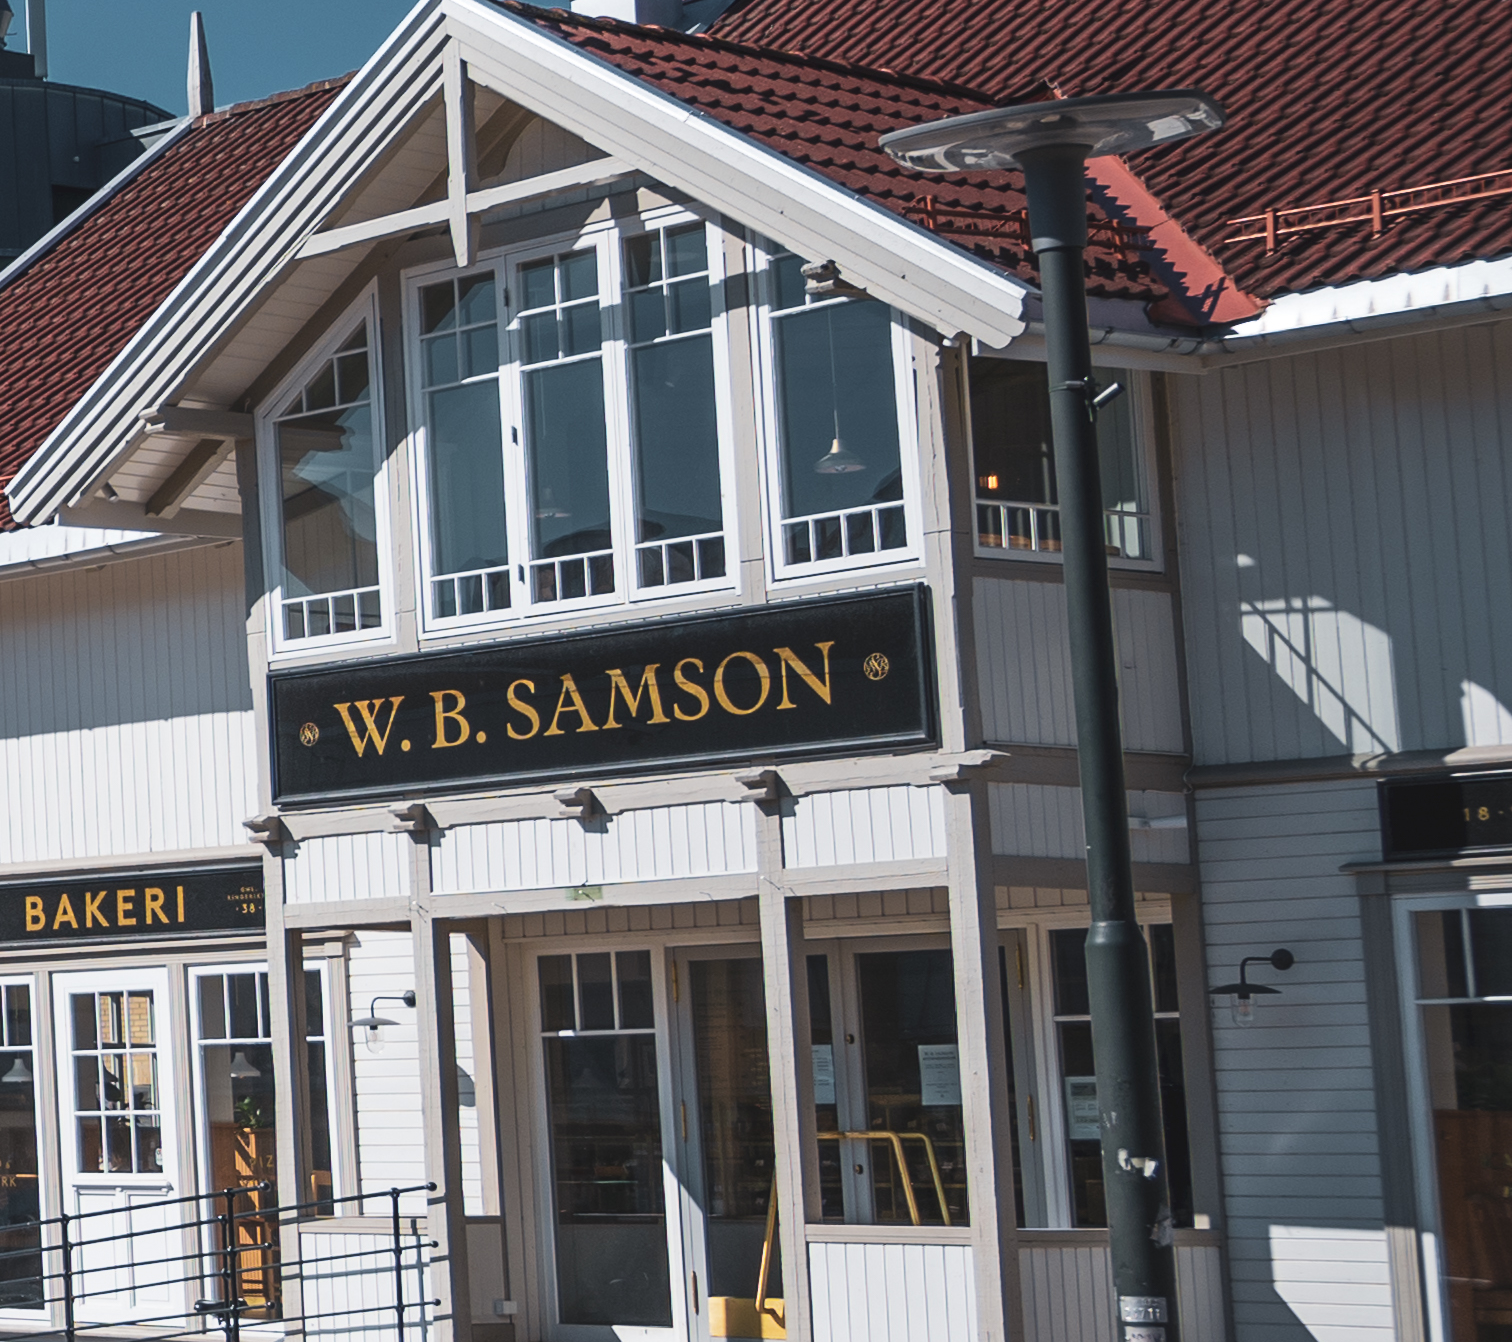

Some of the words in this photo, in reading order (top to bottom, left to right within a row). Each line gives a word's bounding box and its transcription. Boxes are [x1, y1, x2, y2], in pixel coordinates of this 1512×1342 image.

[333, 695, 412, 757] W.
[429, 689, 487, 748] B.
[505, 640, 836, 741] SAMSON
[24, 885, 185, 932] BAKERI
